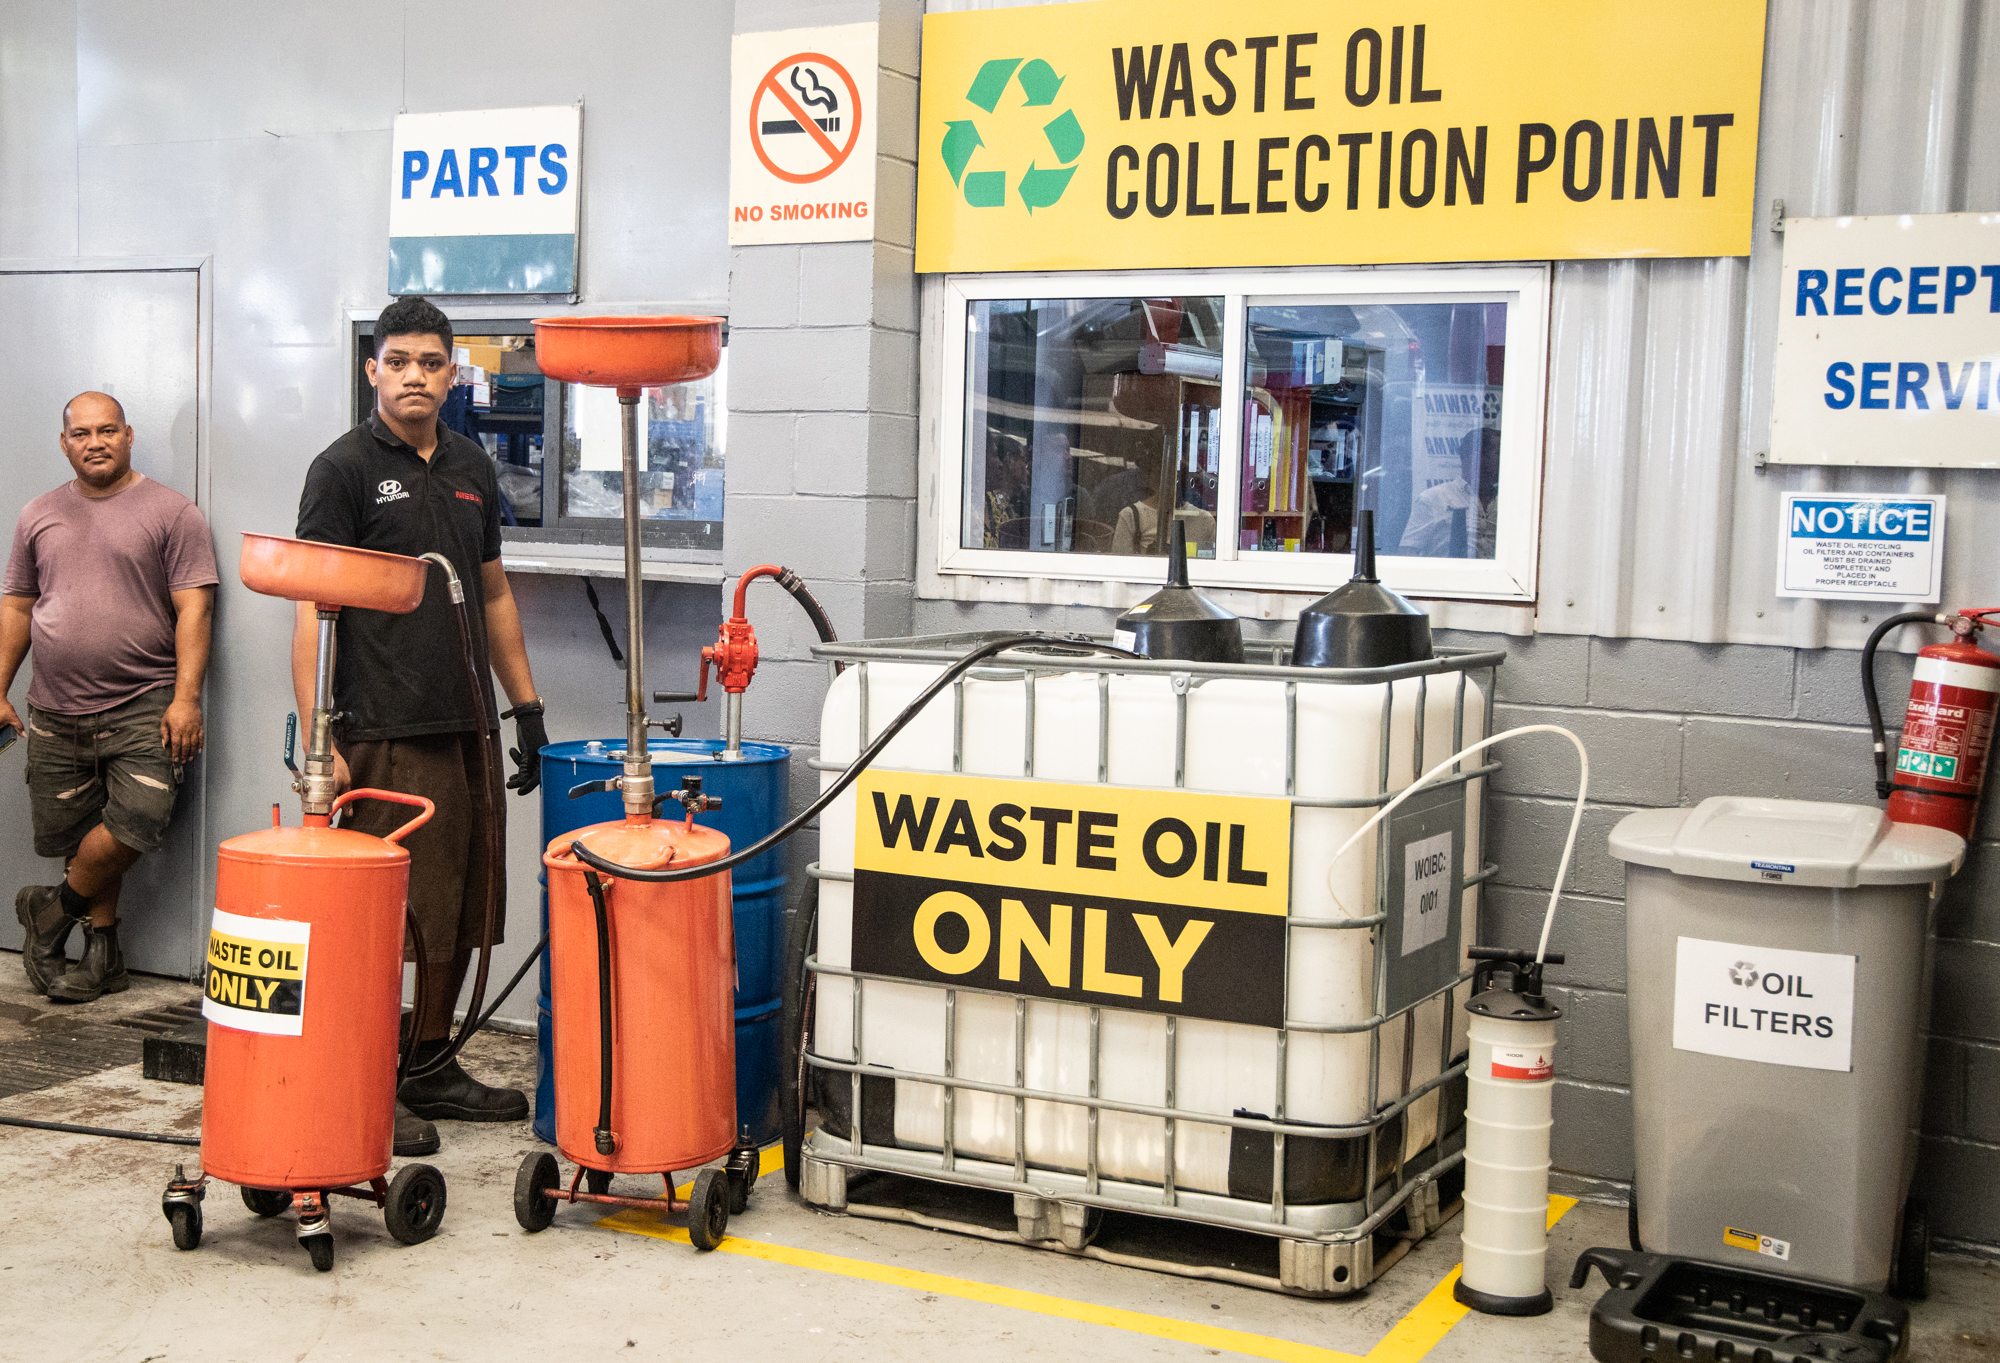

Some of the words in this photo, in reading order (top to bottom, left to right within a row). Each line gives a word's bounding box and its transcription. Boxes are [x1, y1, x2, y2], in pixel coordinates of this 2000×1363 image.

[1111, 32, 1318, 121] WASTE
[1345, 24, 1442, 107] OIL
[402, 143, 568, 199] PARTS
[1106, 125, 1488, 220] COLLECTION
[1515, 113, 1734, 203] POINT
[734, 206, 763, 222] NO
[770, 201, 868, 221] SMOKING
[1795, 264, 2000, 316] RECEPT
[1824, 361, 2000, 410] SERVI
[376, 492, 410, 504] HYUNDAI
[1793, 507, 1928, 535] NOTICE
[1908, 701, 1964, 718] Exelgard
[871, 791, 1119, 872] WASTE
[1142, 817, 1268, 887] OIL
[1415, 852, 1446, 881] WOIBC:
[1754, 862, 1792, 871] TRAMONTINA
[210, 936, 252, 966] WASTE
[258, 949, 298, 971] OIL
[913, 890, 1215, 1004] ONLY
[210, 969, 281, 1009] ONLY
[1762, 972, 1813, 998] OIL
[1705, 1003, 1833, 1038] FILTERS
